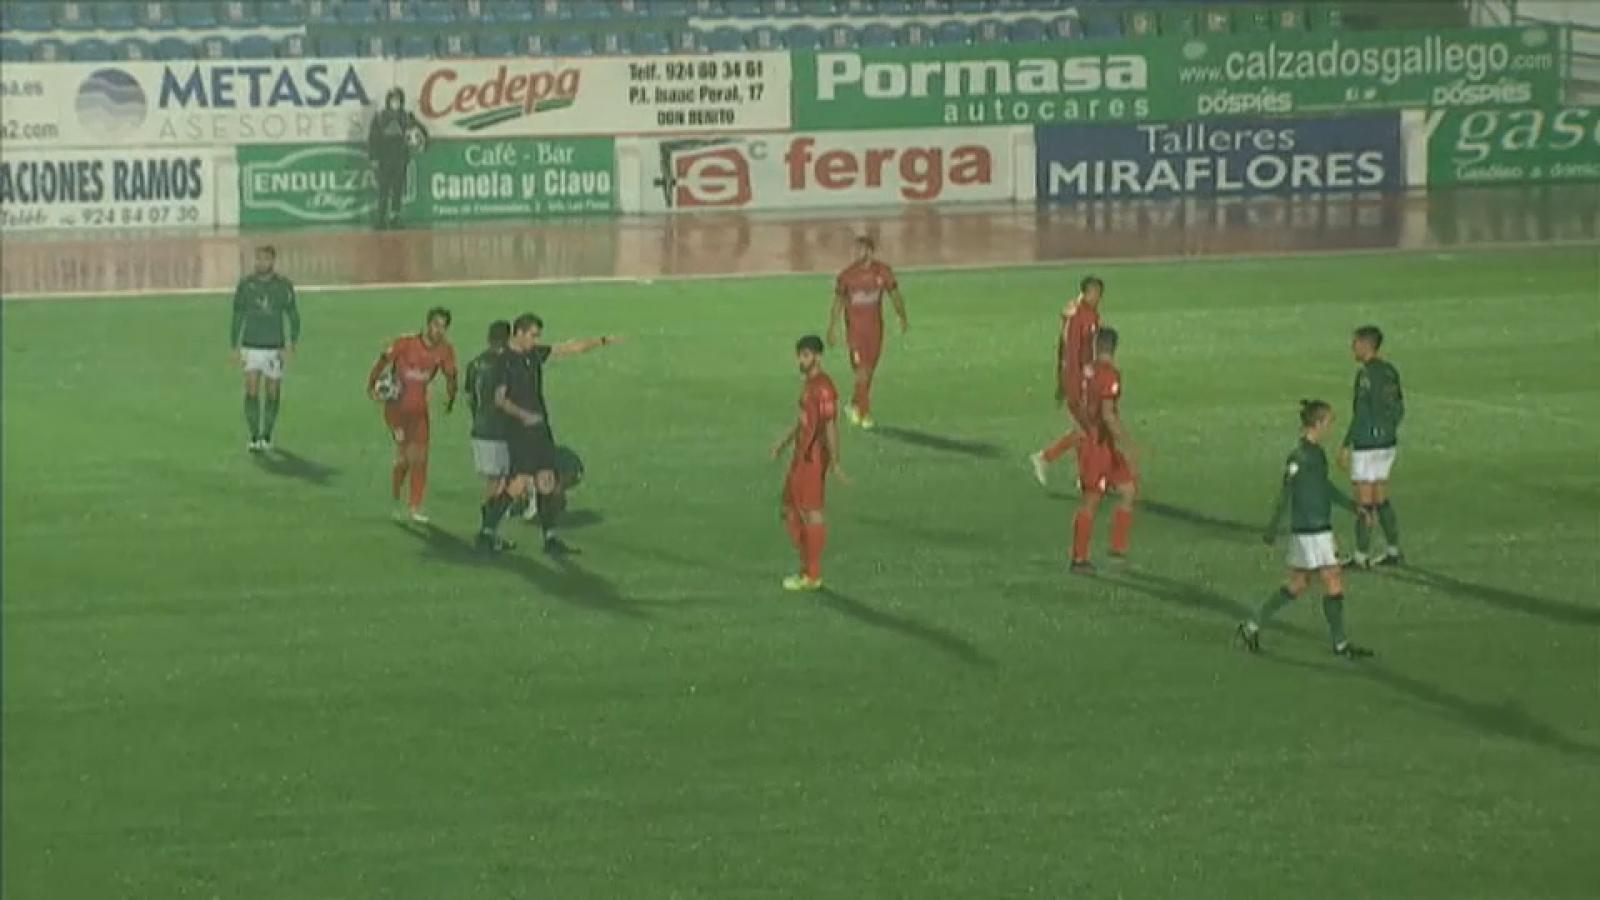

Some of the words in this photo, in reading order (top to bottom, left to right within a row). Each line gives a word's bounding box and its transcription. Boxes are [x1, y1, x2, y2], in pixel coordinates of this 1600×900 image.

[158, 64, 369, 109] METASA
[419, 65, 581, 119] Cedepa
[815, 52, 1149, 101] Pormasa
[159, 111, 364, 142] ASESORES
[944, 97, 1149, 122] autocares
[465, 143, 517, 167] Café
[538, 143, 576, 164] Bar
[1137, 122, 1296, 155] Talleres
[113, 158, 203, 201] RAMOS
[431, 172, 513, 200] Canela
[544, 168, 611, 196] Clavo
[784, 137, 992, 200] ferga
[1048, 149, 1385, 196] MIRAFLORES
[82, 207, 115, 224] 924
[177, 205, 200, 222] 30
